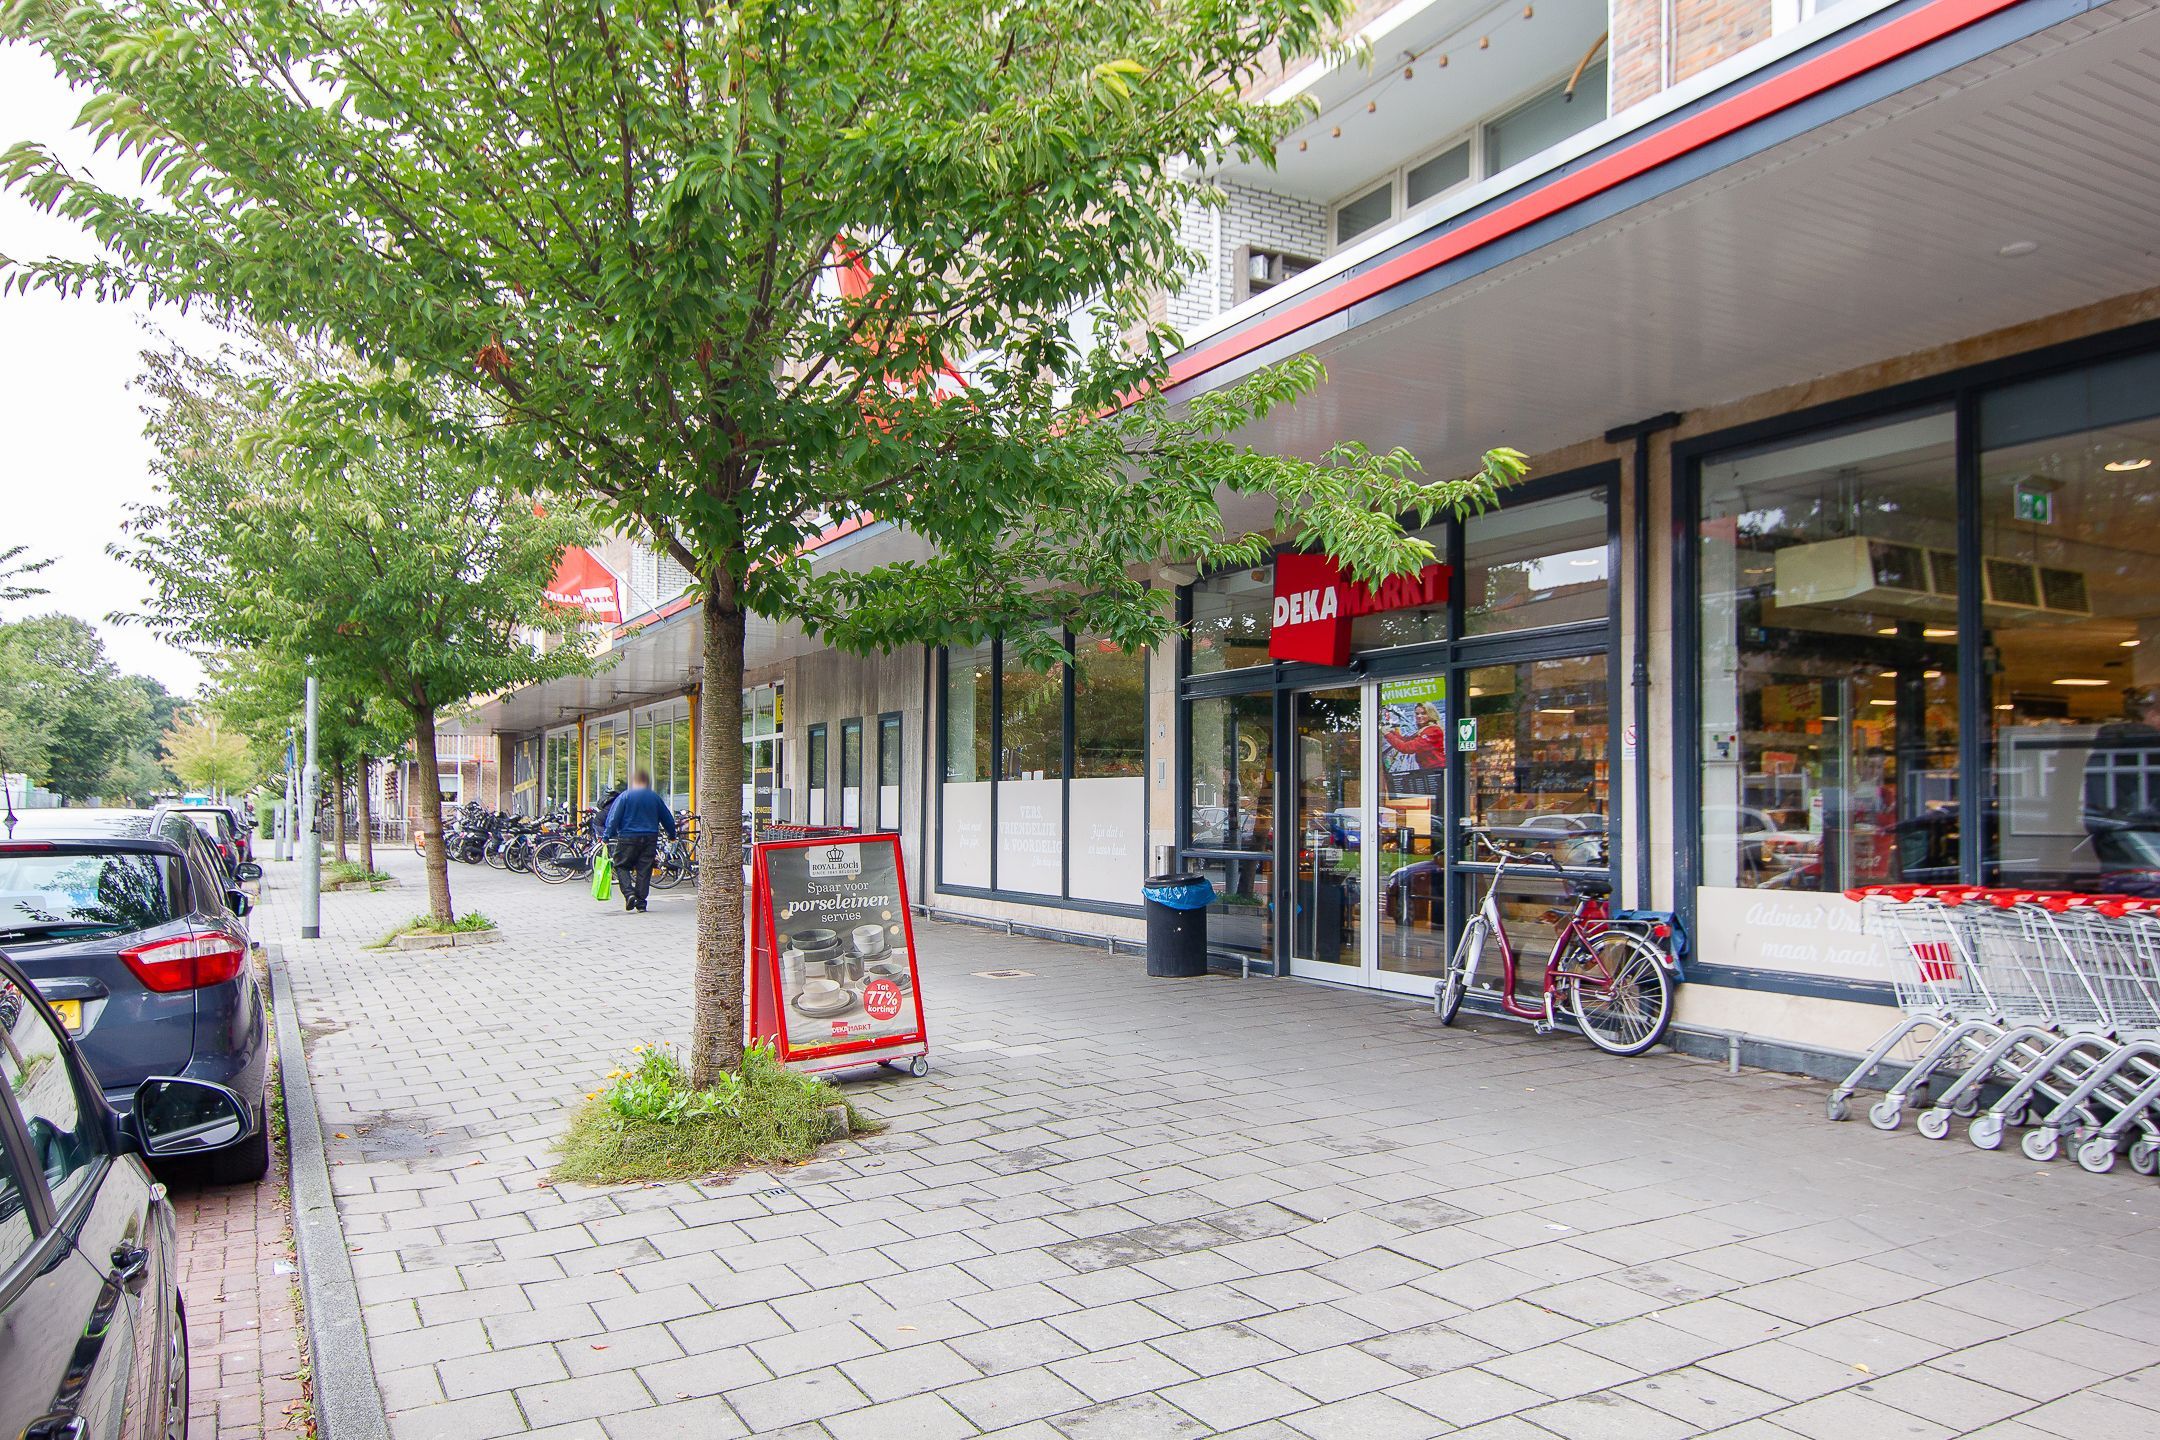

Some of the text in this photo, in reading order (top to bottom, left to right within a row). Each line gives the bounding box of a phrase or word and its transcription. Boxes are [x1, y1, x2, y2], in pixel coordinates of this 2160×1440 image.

[812, 863, 837, 871] ROYAL
[807, 882, 869, 895] Spaar voor
[788, 893, 890, 917] porseleinen
[821, 910, 862, 923] servies
[1745, 902, 1825, 929] Advies?
[1760, 942, 1819, 961] maar
[867, 991, 898, 1006] 77%
[867, 1005, 897, 1014] korting!
